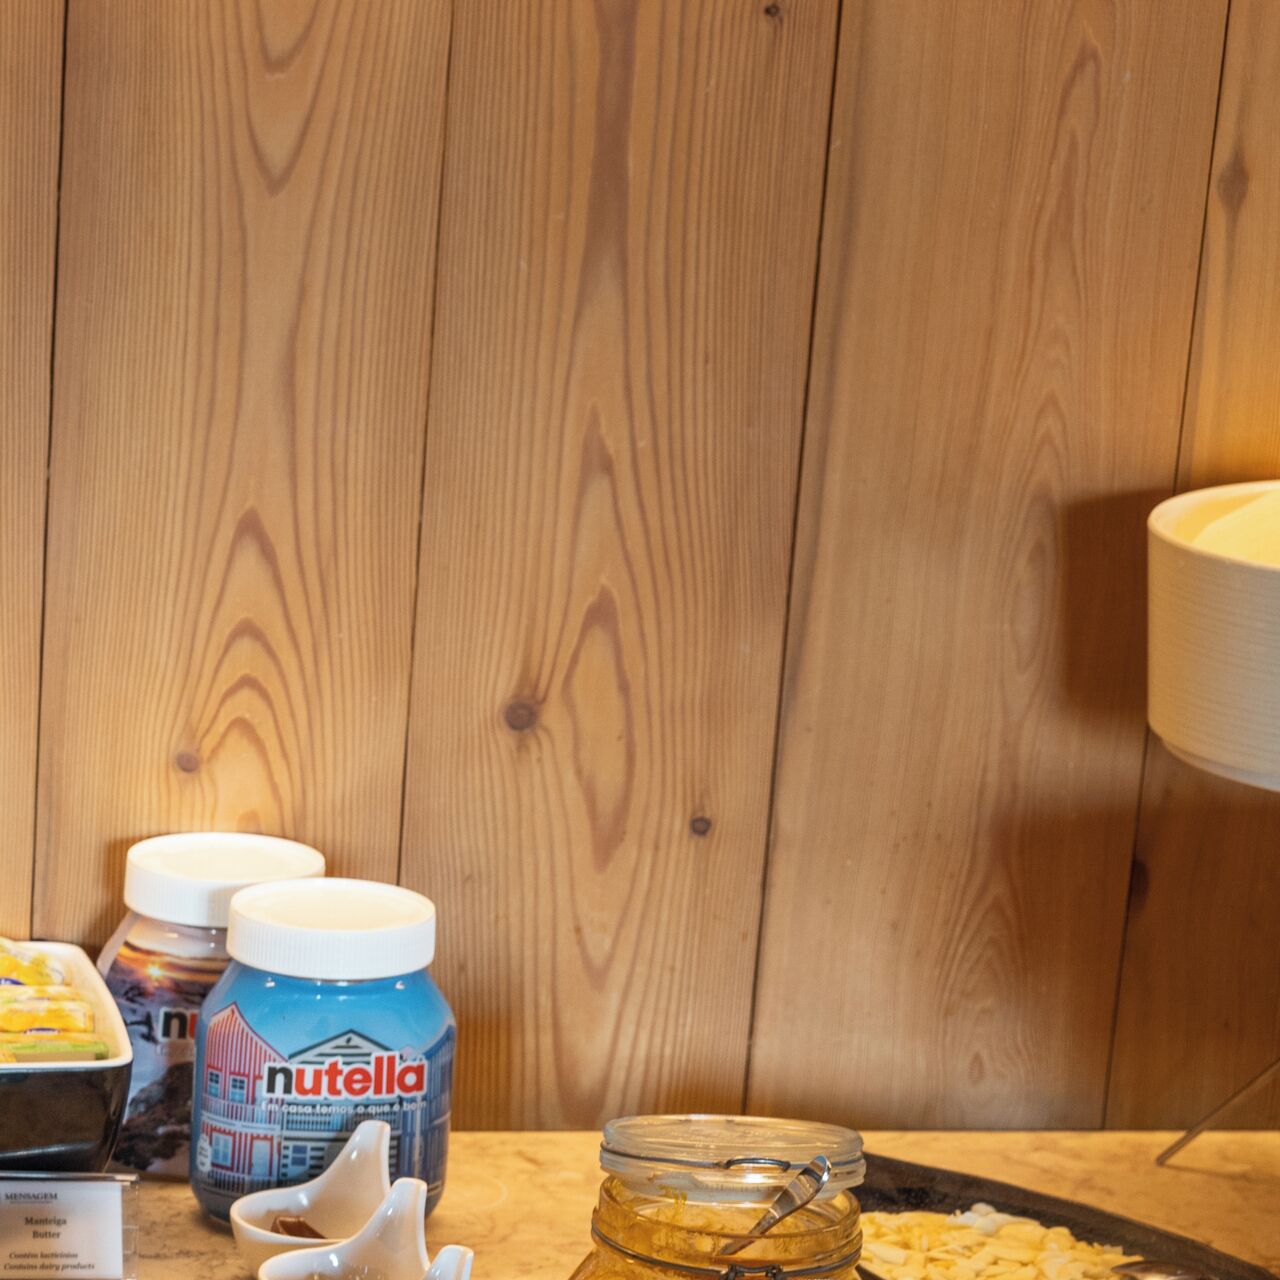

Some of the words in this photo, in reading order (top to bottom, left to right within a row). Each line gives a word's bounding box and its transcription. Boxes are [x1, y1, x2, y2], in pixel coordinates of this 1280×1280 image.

[267, 1055, 425, 1096] nutella
[282, 1104, 312, 1113] casa
[316, 1104, 353, 1113] temos
[5, 1192, 58, 1200] MENSAGEM
[25, 1217, 66, 1226] Manteiga
[32, 1231, 61, 1239] Butter
[61, 1263, 95, 1271] products
